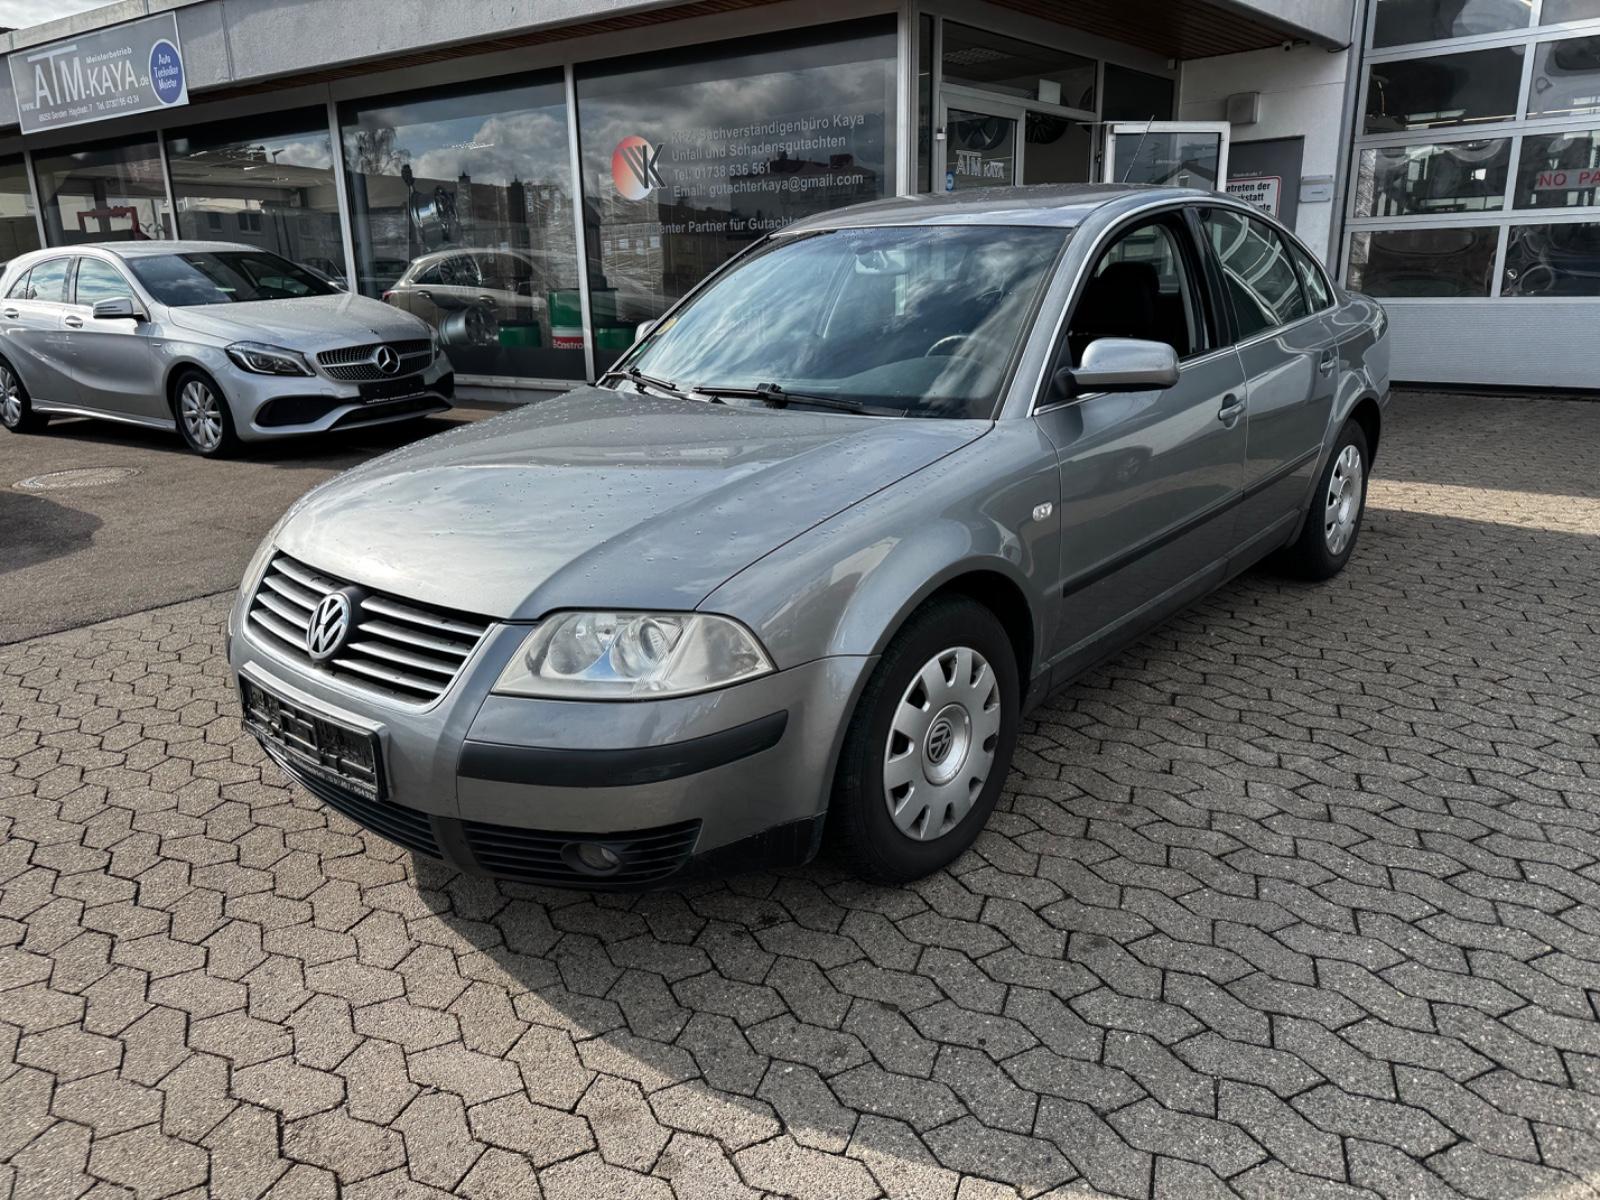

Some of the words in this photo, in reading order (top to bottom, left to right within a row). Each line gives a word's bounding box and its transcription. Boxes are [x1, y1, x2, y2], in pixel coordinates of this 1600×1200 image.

[86, 46, 132, 63] Meisterbetrieb
[158, 53, 171, 65] Auto
[833, 113, 865, 130] Kaya
[671, 147, 703, 162] Unfall
[705, 143, 726, 159] und
[729, 135, 846, 156] Schadensgutachten
[695, 163, 726, 179] 01738
[729, 162, 749, 177] 536
[752, 160, 771, 175] 561
[955, 150, 982, 177] ATM
[1226, 183, 1255, 193] etreten
[1257, 182, 1271, 191] der
[1538, 172, 1567, 187] NO
[673, 182, 706, 198] Email:
[688, 219, 727, 233] Partner
[730, 217, 746, 231] für
